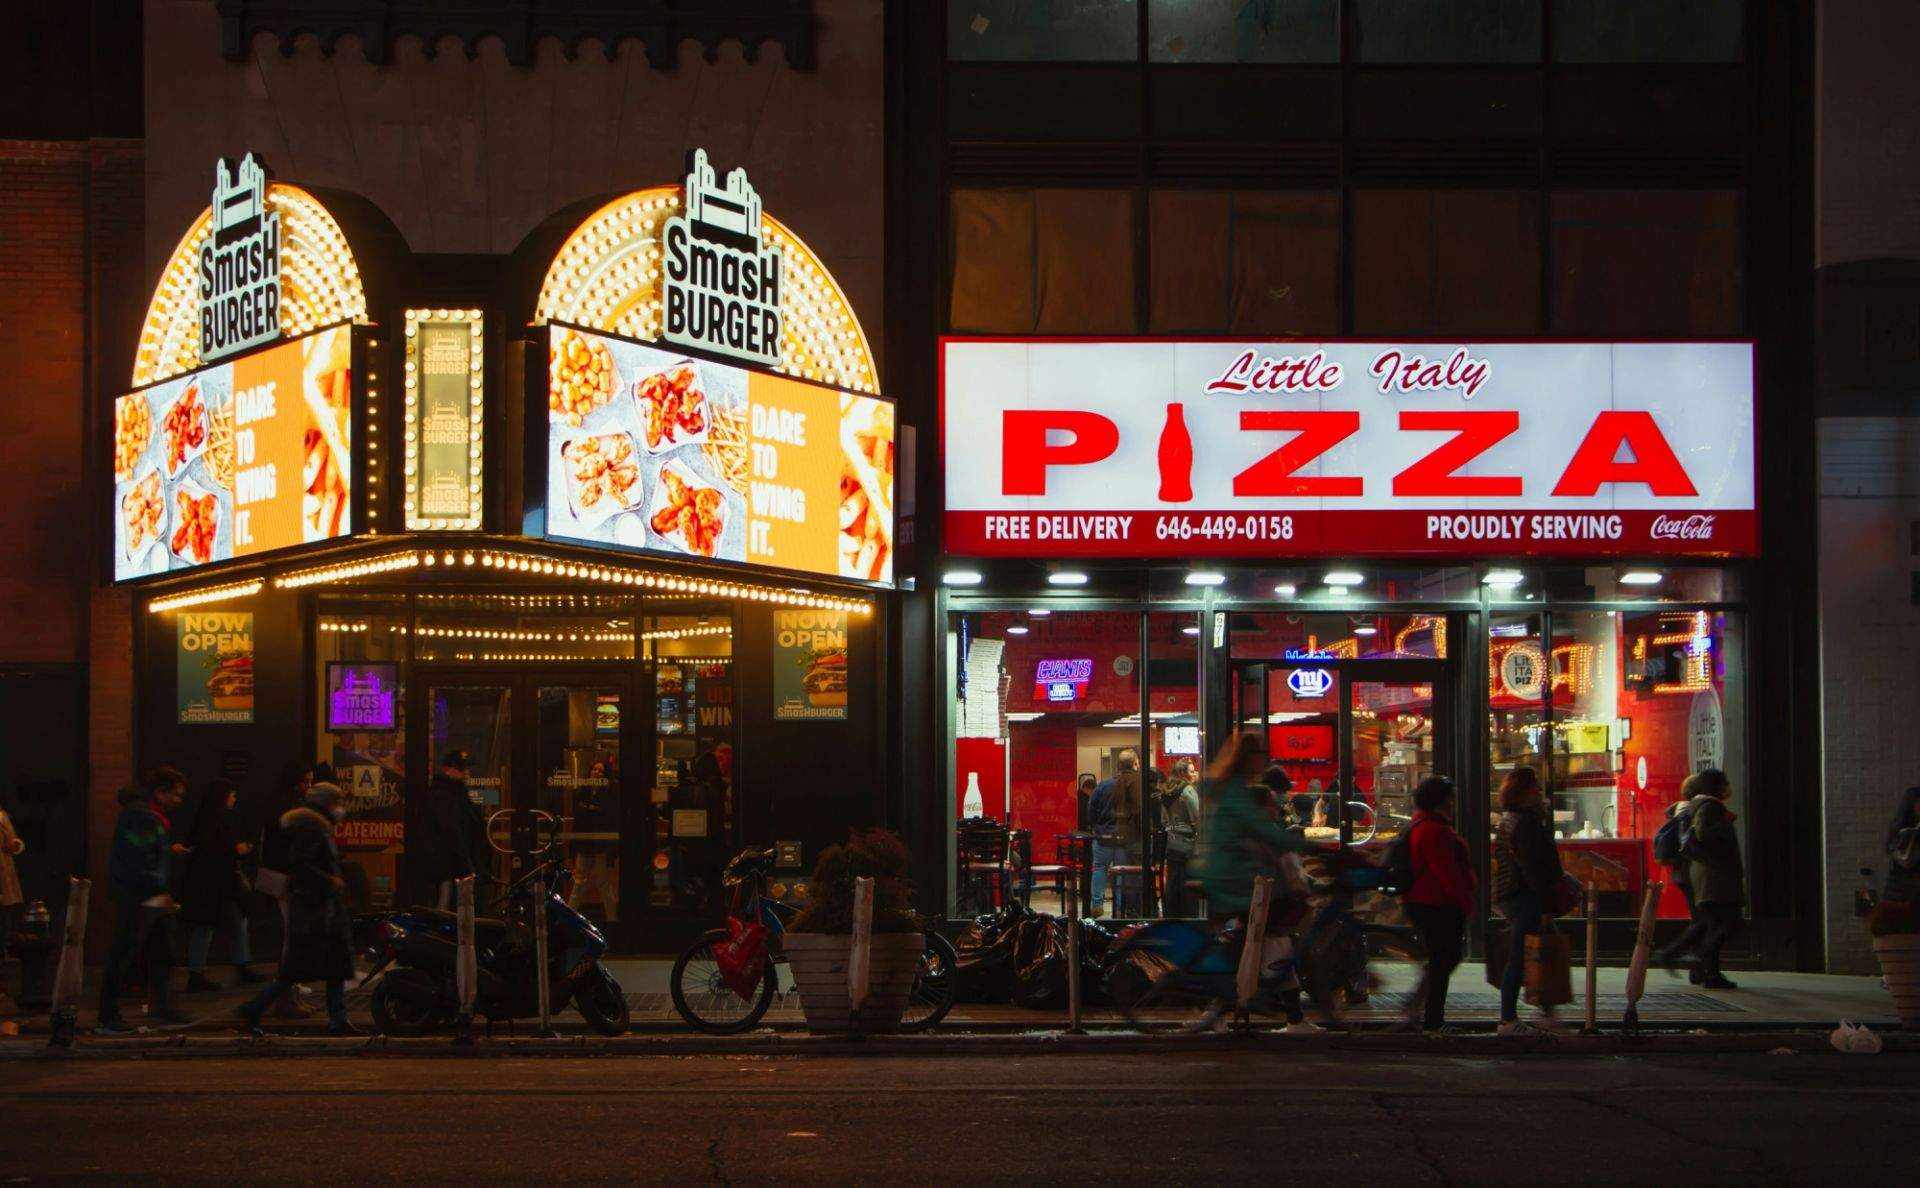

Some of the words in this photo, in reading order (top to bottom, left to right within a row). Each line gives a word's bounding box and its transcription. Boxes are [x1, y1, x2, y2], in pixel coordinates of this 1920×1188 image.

[202, 282, 279, 354] BURGER
[667, 284, 780, 358] BURGER
[423, 361, 469, 375] BURGER
[1206, 350, 1341, 391] Little
[1372, 349, 1488, 397] Italy
[235, 381, 277, 426] DARE
[423, 430, 469, 444] BURGER
[752, 403, 806, 447] DARE
[236, 429, 255, 466] TO
[752, 443, 777, 480] TO
[236, 463, 277, 505] WING
[423, 500, 469, 514] BURGER
[752, 483, 806, 523] WING
[236, 511, 253, 546] IT.
[750, 519, 775, 556] IT.
[985, 516, 1030, 540] FREE
[1037, 516, 1133, 540] DELIVERY
[1156, 516, 1294, 540] 646-449-0158
[1427, 515, 1525, 540] PROUDLY
[1531, 515, 1623, 540] SERVING
[1650, 514, 1717, 540] Coca-Cola
[185, 614, 248, 633] NOW
[780, 611, 840, 630] NOW
[181, 633, 251, 652] OPEN
[778, 630, 844, 649] OPEN
[1036, 658, 1092, 680] GIANTS
[358, 769, 375, 788] A
[334, 822, 404, 838] CATERING
